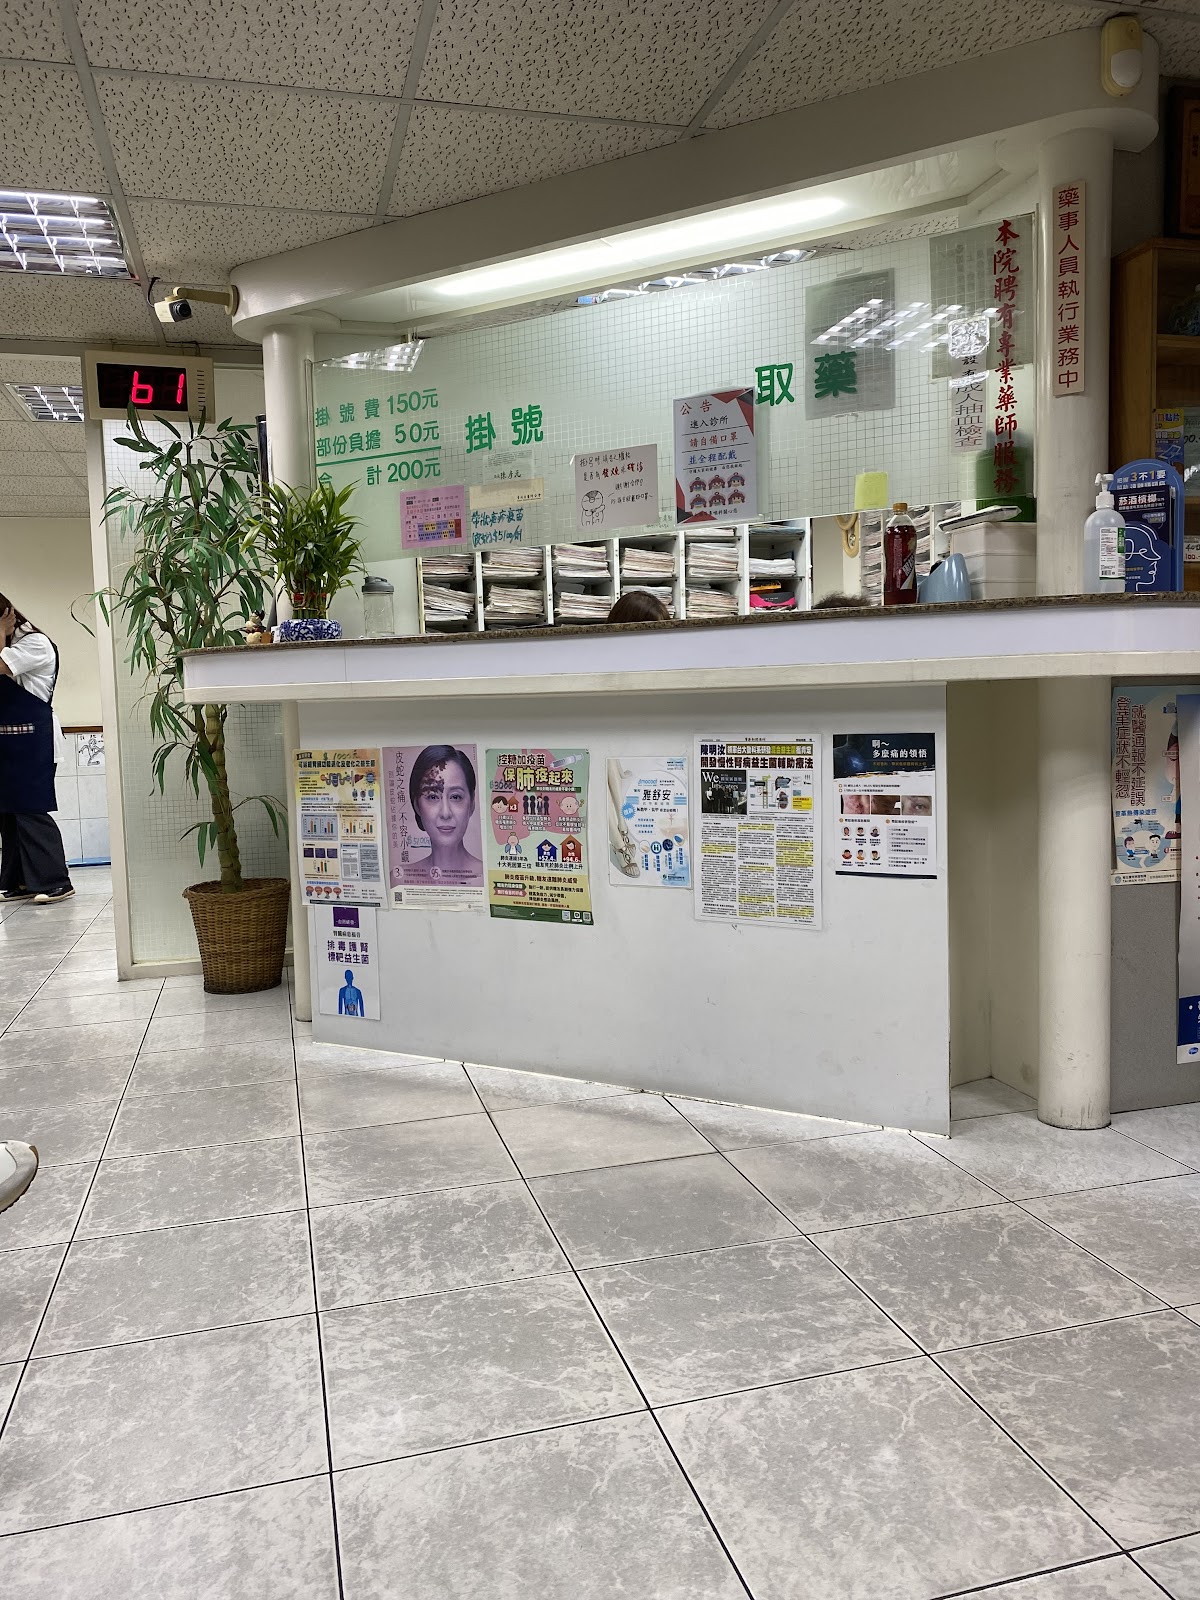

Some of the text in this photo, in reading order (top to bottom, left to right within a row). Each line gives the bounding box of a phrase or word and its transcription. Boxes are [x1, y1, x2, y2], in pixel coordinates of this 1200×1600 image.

[1057, 187, 1079, 388] 藥事人員執行業務中
[993, 220, 1020, 494] 本院聘有專業藥師服務
[755, 351, 857, 407] 取藥
[315, 388, 439, 427] 掛號費 150元
[680, 399, 712, 416] 公告
[465, 404, 544, 454] 掛號
[690, 415, 728, 429] 進入診所
[316, 421, 440, 457] 部份負擔 50元
[689, 431, 738, 448] 請自備口罩
[688, 450, 737, 466] 並全程配戴
[387, 457, 440, 482] 200元
[701, 744, 725, 755] 陳明汝
[873, 749, 927, 758] 多麼痛的領悟
[1115, 696, 1131, 799] 登革症狀不輕忽
[1131, 705, 1146, 807] 就醫通報不延誤
[498, 754, 545, 766] 控糖加疫苗
[700, 757, 813, 769] 開發慢性腎病益生菌輔助療法
[503, 766, 573, 791] 保肺疫起來
[327, 940, 368, 953] 排毒護腎
[327, 952, 369, 965] 標靶益生菌
